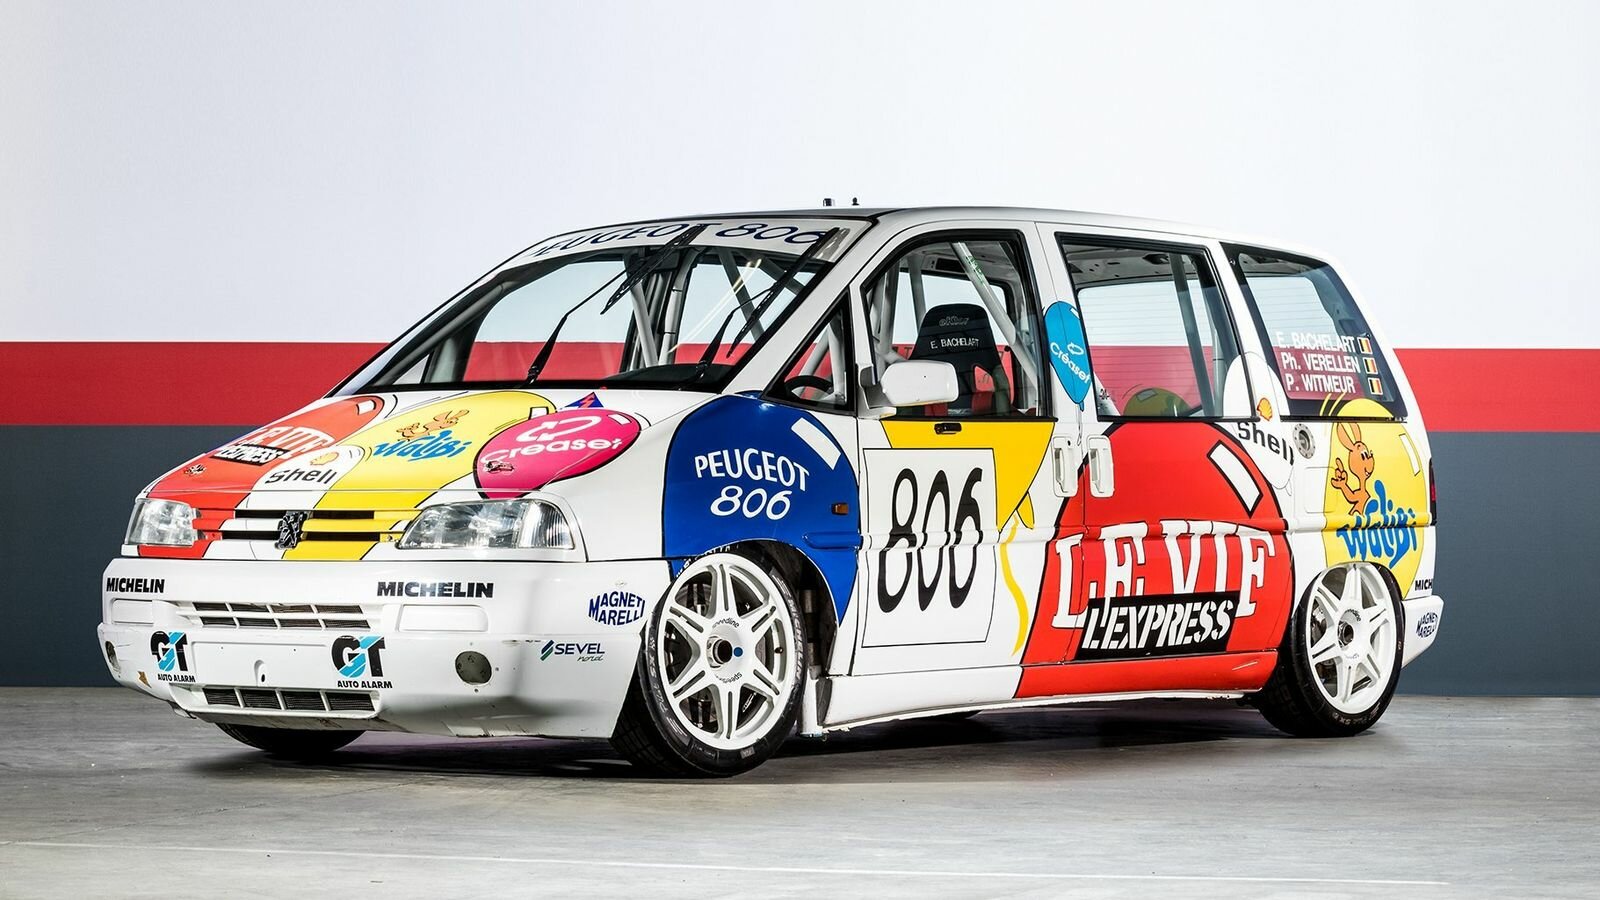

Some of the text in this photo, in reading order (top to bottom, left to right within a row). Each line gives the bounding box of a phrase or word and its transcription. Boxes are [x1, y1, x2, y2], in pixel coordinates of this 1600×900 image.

[715, 223, 829, 244] 806
[1291, 332, 1356, 353] BACHELART
[1281, 352, 1361, 374] Ph. VERELLEN
[1286, 373, 1356, 393] P. WITMEUR
[1238, 422, 1294, 466] Shell
[264, 468, 337, 485] Shell
[694, 448, 810, 492] PEUGEOT
[710, 485, 793, 521] 806
[877, 467, 983, 613] 806
[1051, 518, 1276, 628] LE VIF
[106, 577, 165, 593] MICHELIN
[377, 581, 494, 598] MICHELIN
[1081, 599, 1234, 649] L'EXPRESS
[150, 630, 188, 672] GT
[331, 635, 386, 678] GT
[554, 643, 605, 655] SEVEL
[157, 673, 195, 683] AUTO ALARM
[337, 680, 393, 689] AUTO ALARM
